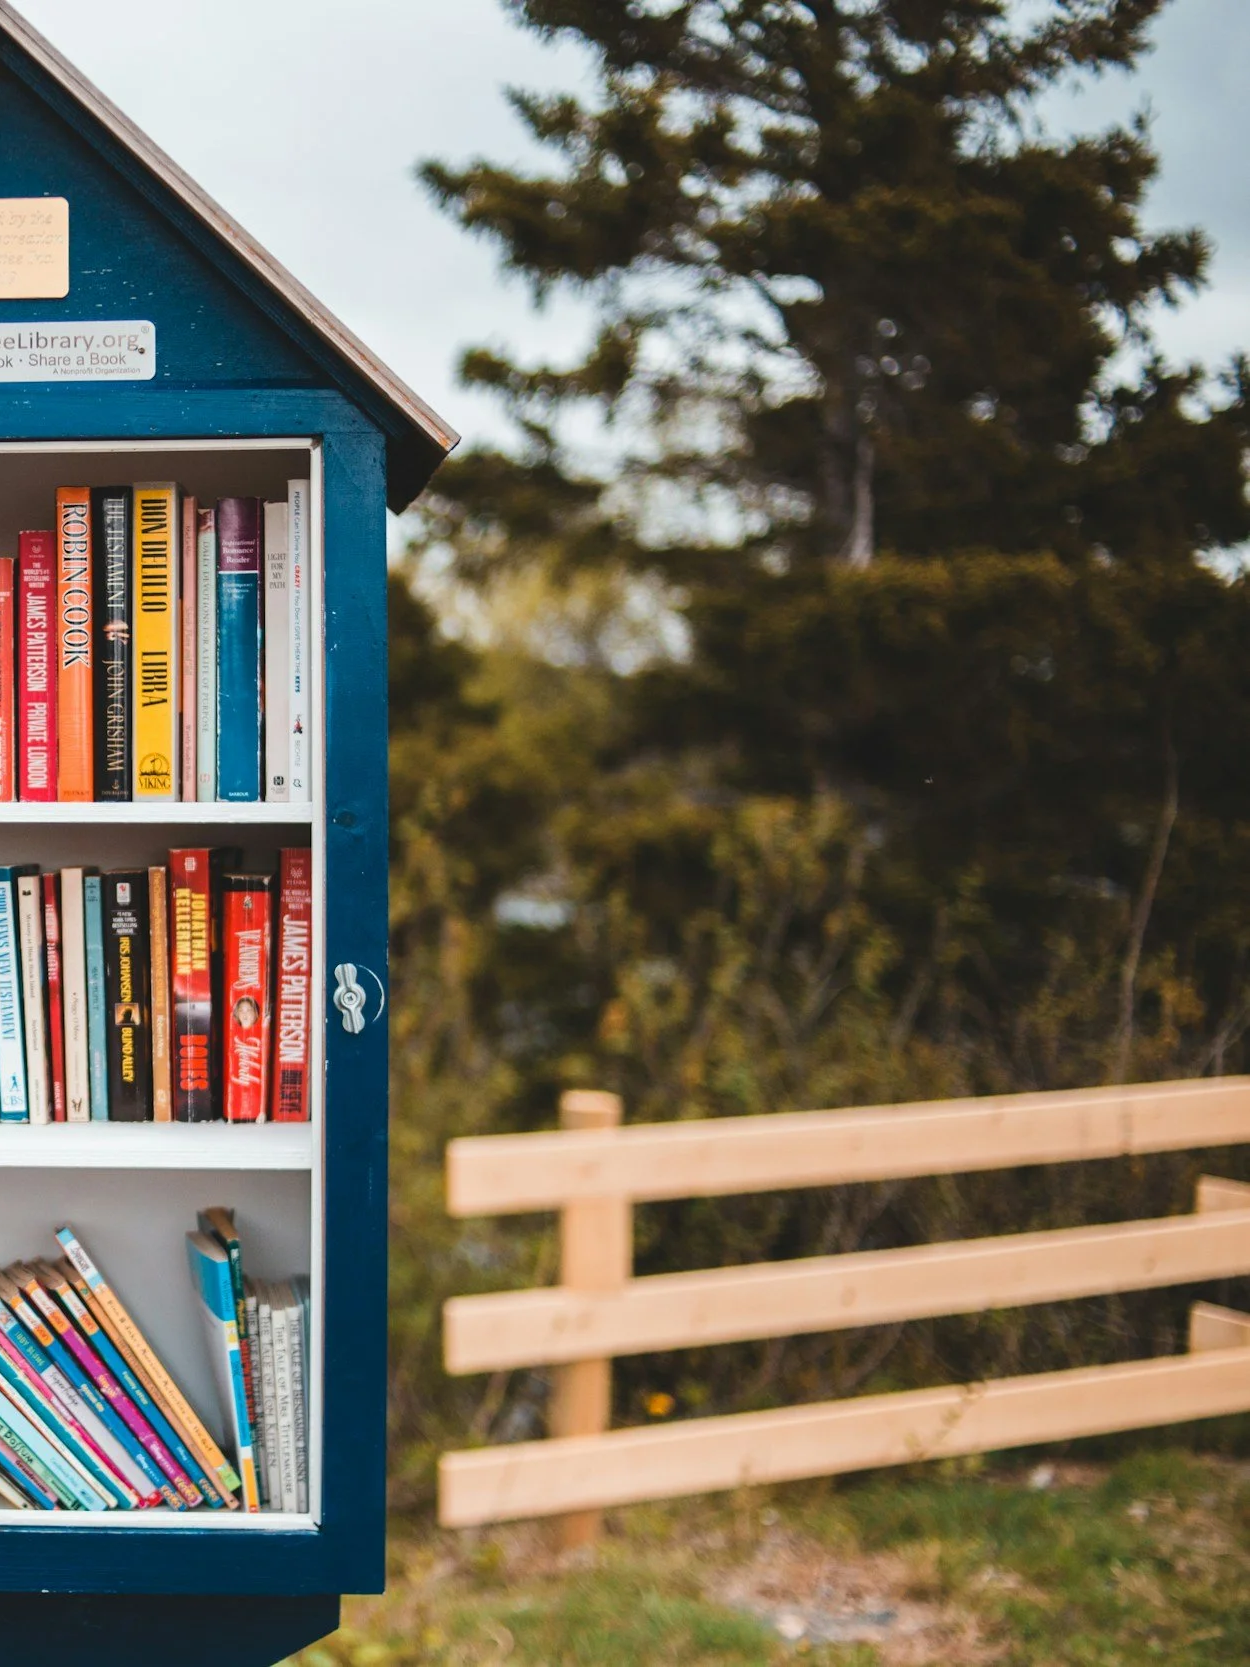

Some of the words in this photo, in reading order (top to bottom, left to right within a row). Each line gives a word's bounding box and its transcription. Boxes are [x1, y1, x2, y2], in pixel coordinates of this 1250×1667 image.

[9, 210, 26, 228] by
[31, 210, 52, 224] the
[28, 354, 70, 366] Share
[76, 357, 84, 365] a
[90, 353, 126, 365] Book
[95, 367, 140, 375] Organization
[107, 498, 124, 522] THE
[141, 499, 167, 533] DON
[62, 503, 89, 582] ROBIN
[222, 539, 255, 549] Inspirational
[107, 528, 124, 609] TESTAMENT
[267, 553, 286, 561] LIGHT
[141, 540, 167, 612] DELILLO
[268, 584, 286, 592] PATH
[273, 574, 282, 582] MY
[26, 593, 46, 628] JAMES
[62, 588, 90, 670] COOK
[26, 632, 46, 690] PATTERSON
[102, 660, 124, 697] JOHN
[141, 651, 168, 707] LIBRA
[202, 677, 208, 689] OF
[27, 702, 47, 742] PRIVATE
[106, 703, 124, 770] GRISHAM
[27, 746, 47, 787] LONDON
[139, 777, 171, 790] VIKING
[119, 936, 130, 953] IRIS
[175, 888, 190, 974] KELLERMAN
[191, 893, 206, 969] JONATHAN
[281, 914, 308, 971] JAMES
[119, 955, 132, 1001] JOHANSEN
[279, 974, 307, 1062] PATTERSON
[121, 1027, 133, 1054] BLIND
[121, 1055, 133, 1081] ALLEY
[180, 1034, 207, 1090] BONES
[231, 1036, 260, 1085] Melody
[247, 1309, 257, 1326] THE
[259, 1315, 271, 1335] THE
[289, 1318, 300, 1336] THE
[249, 1333, 259, 1355] TALE
[274, 1325, 286, 1345] THE
[250, 1359, 259, 1372] OF
[261, 1340, 273, 1367] TALE
[276, 1348, 287, 1372] TALE
[290, 1340, 302, 1367] TALE
[120, 1370, 137, 1391] Family
[252, 1376, 262, 1407] PETER
[263, 1372, 273, 1387] OF
[277, 1377, 287, 1391] OF
[292, 1372, 302, 1386] OF
[264, 1392, 276, 1415] TOM
[292, 1389, 305, 1441] BENJAMIN
[266, 1423, 279, 1467] KITTEN
[280, 1424, 294, 1493] TITTLEMOUSE
[295, 1447, 307, 1483] BUNNY
